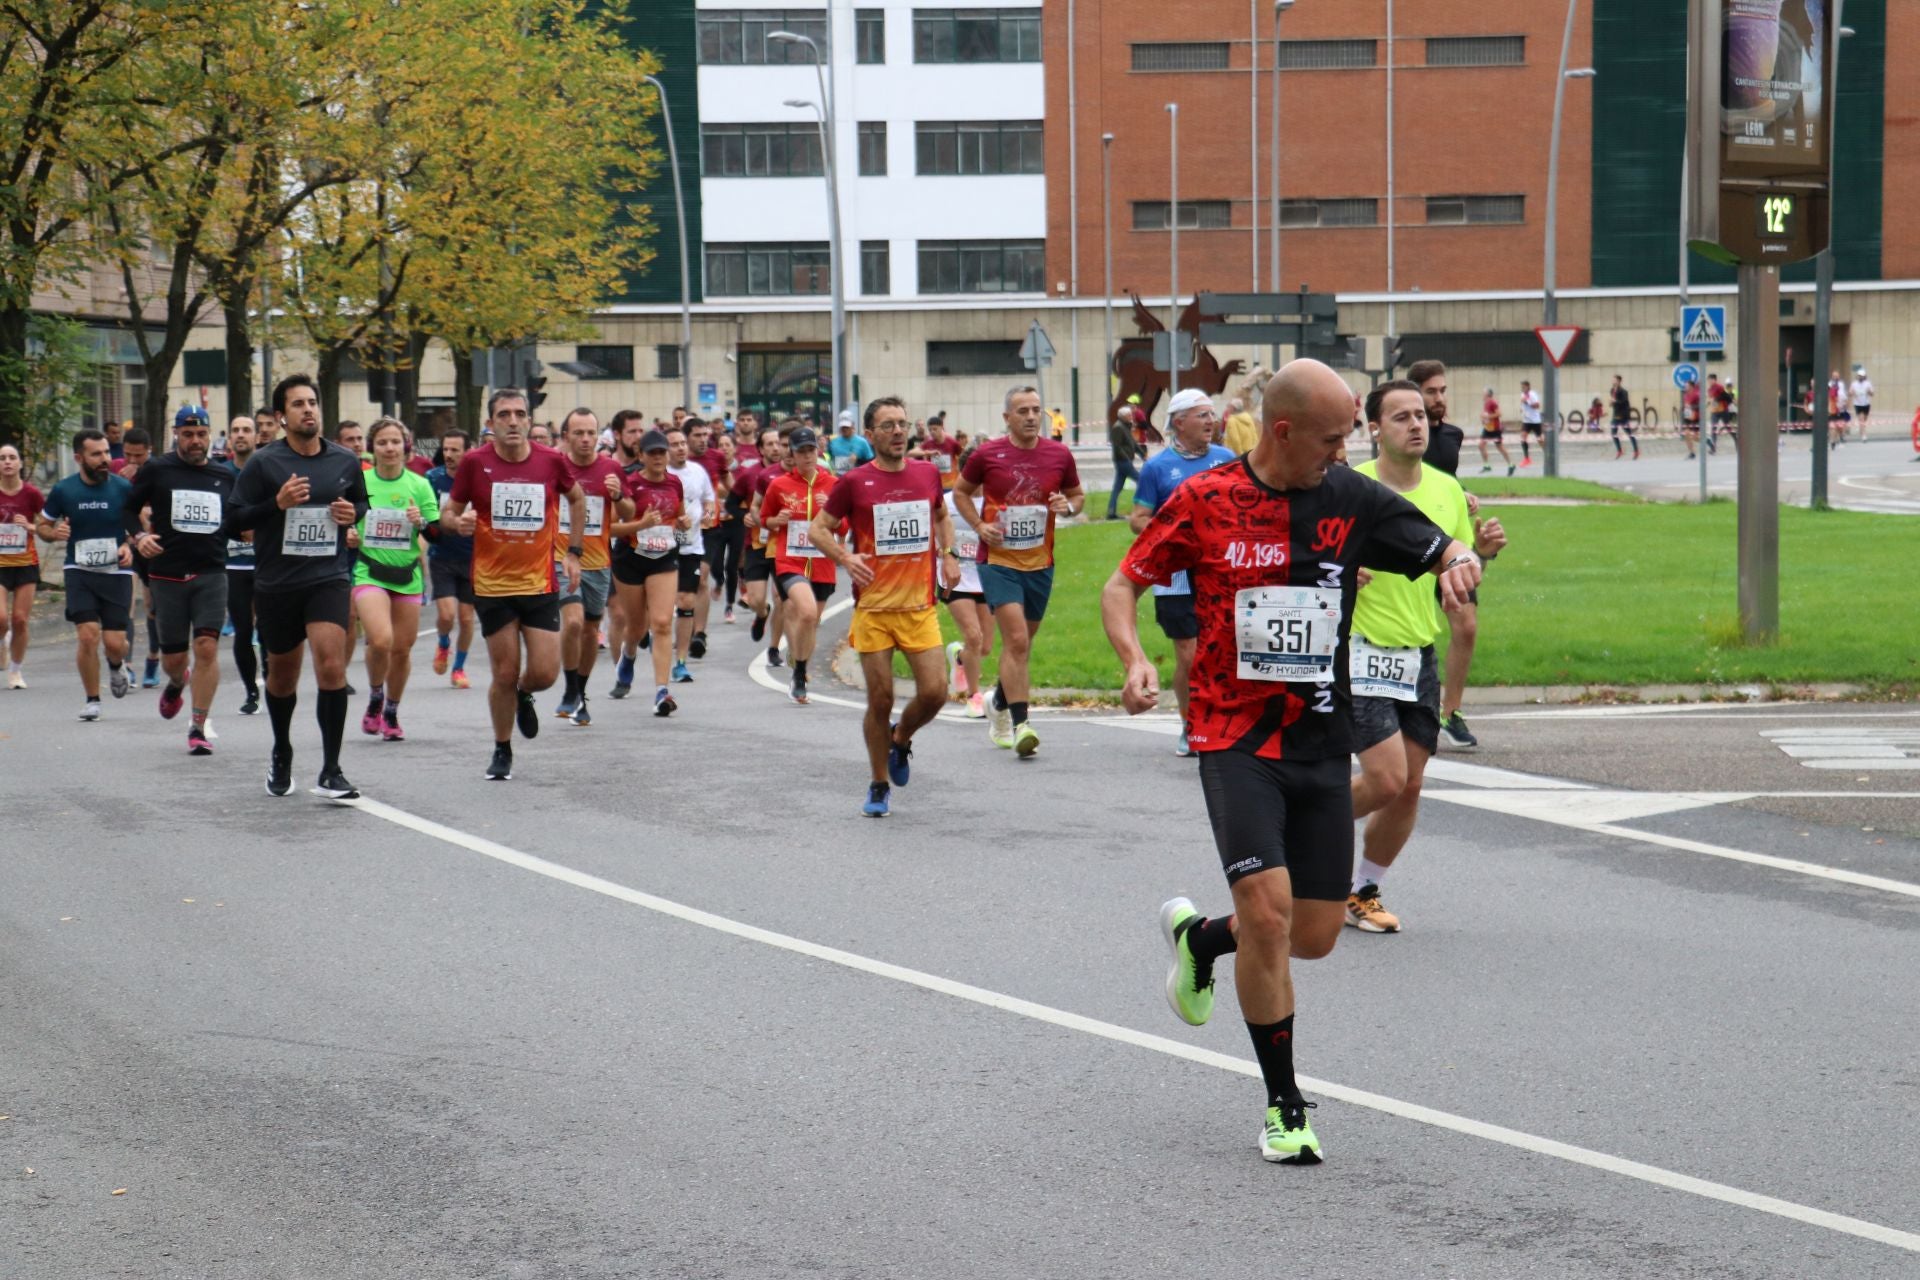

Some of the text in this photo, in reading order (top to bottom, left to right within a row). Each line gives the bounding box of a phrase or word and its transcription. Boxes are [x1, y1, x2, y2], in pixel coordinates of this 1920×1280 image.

[184, 505, 209, 521] 395
[504, 499, 532, 517] 672
[298, 524, 326, 542] 604
[376, 522, 402, 537] 807
[888, 519, 919, 538] 460
[1011, 520, 1036, 537] 663
[1311, 516, 1356, 560] SOY
[86, 550, 108, 565] 327
[1224, 541, 1285, 569] 42,195
[1278, 609, 1302, 617] SANTI
[1267, 619, 1312, 654] 351
[1276, 665, 1318, 676] HYUNDAI
[1367, 655, 1405, 681] 635
